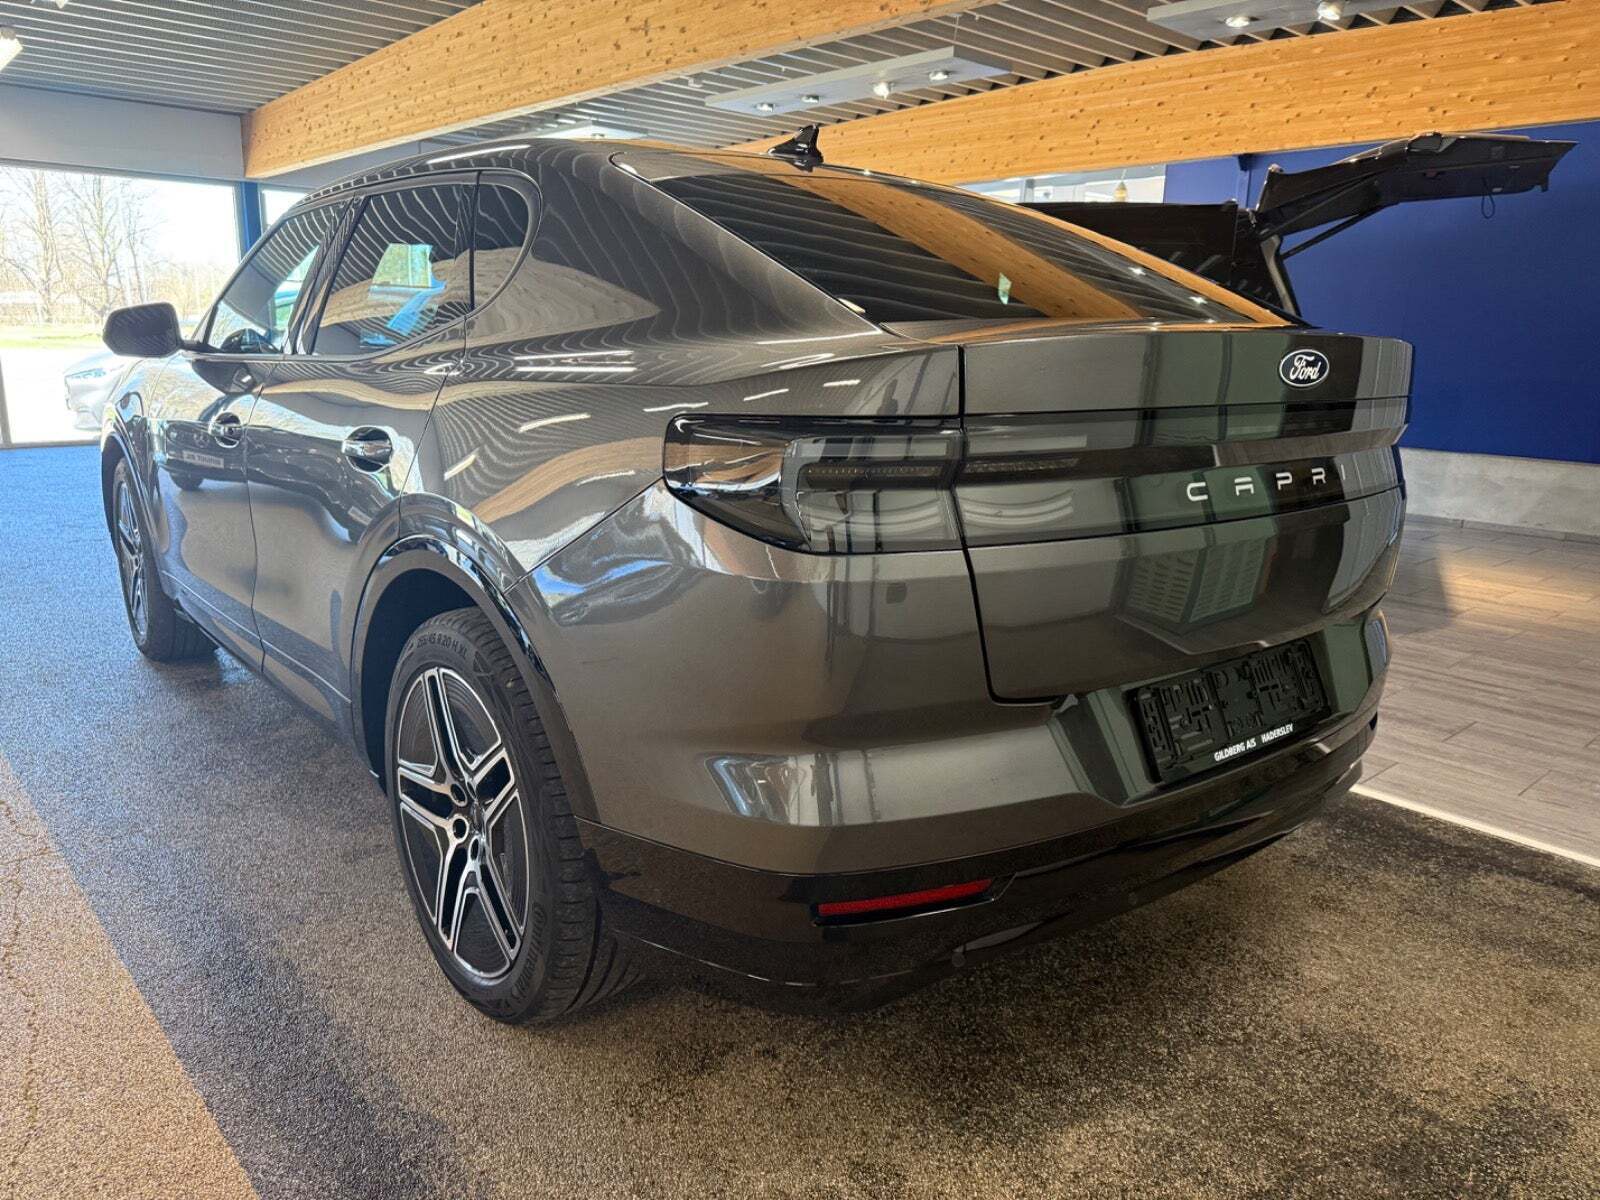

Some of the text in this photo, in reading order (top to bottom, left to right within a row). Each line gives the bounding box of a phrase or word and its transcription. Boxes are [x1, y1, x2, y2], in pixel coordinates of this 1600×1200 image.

[1290, 354, 1321, 380] Ford
[1186, 464, 1346, 501] CAPRI
[1214, 742, 1246, 762] GILDBERG
[1261, 723, 1293, 743] HADERSLEV
